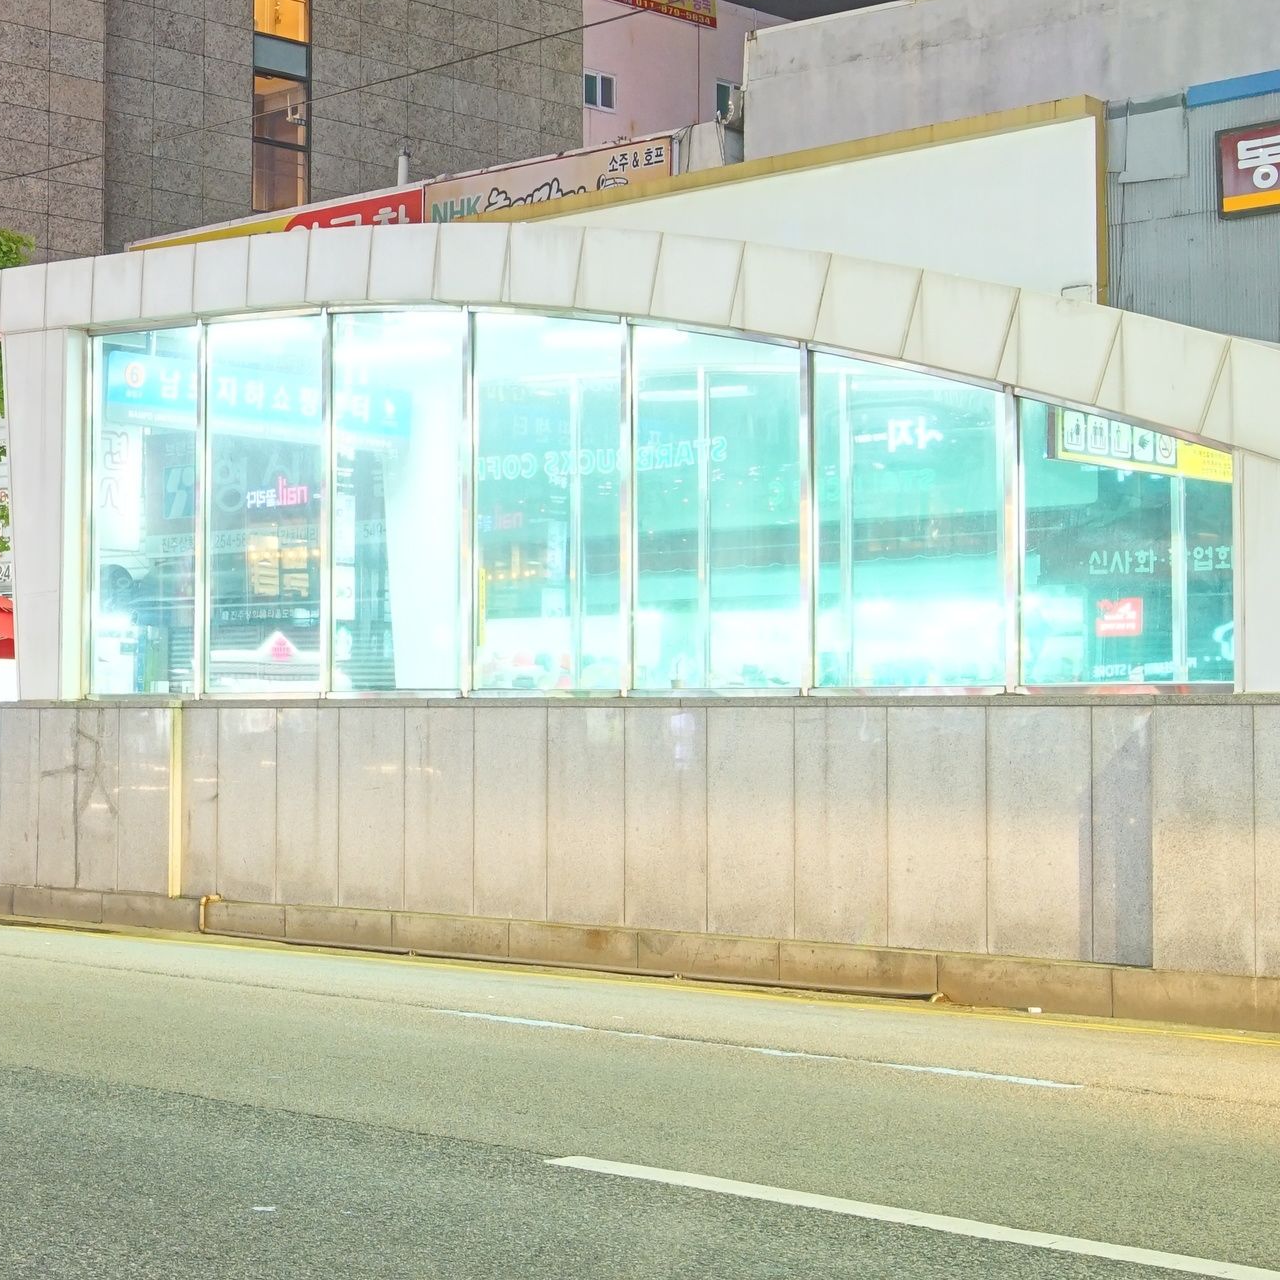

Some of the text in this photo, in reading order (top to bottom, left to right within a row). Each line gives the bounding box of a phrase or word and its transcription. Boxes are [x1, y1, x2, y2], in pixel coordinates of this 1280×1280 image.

[608, 146, 665, 173] 소주 & 호프
[431, 195, 483, 223] NHK
[1088, 548, 1158, 576] 신사화
